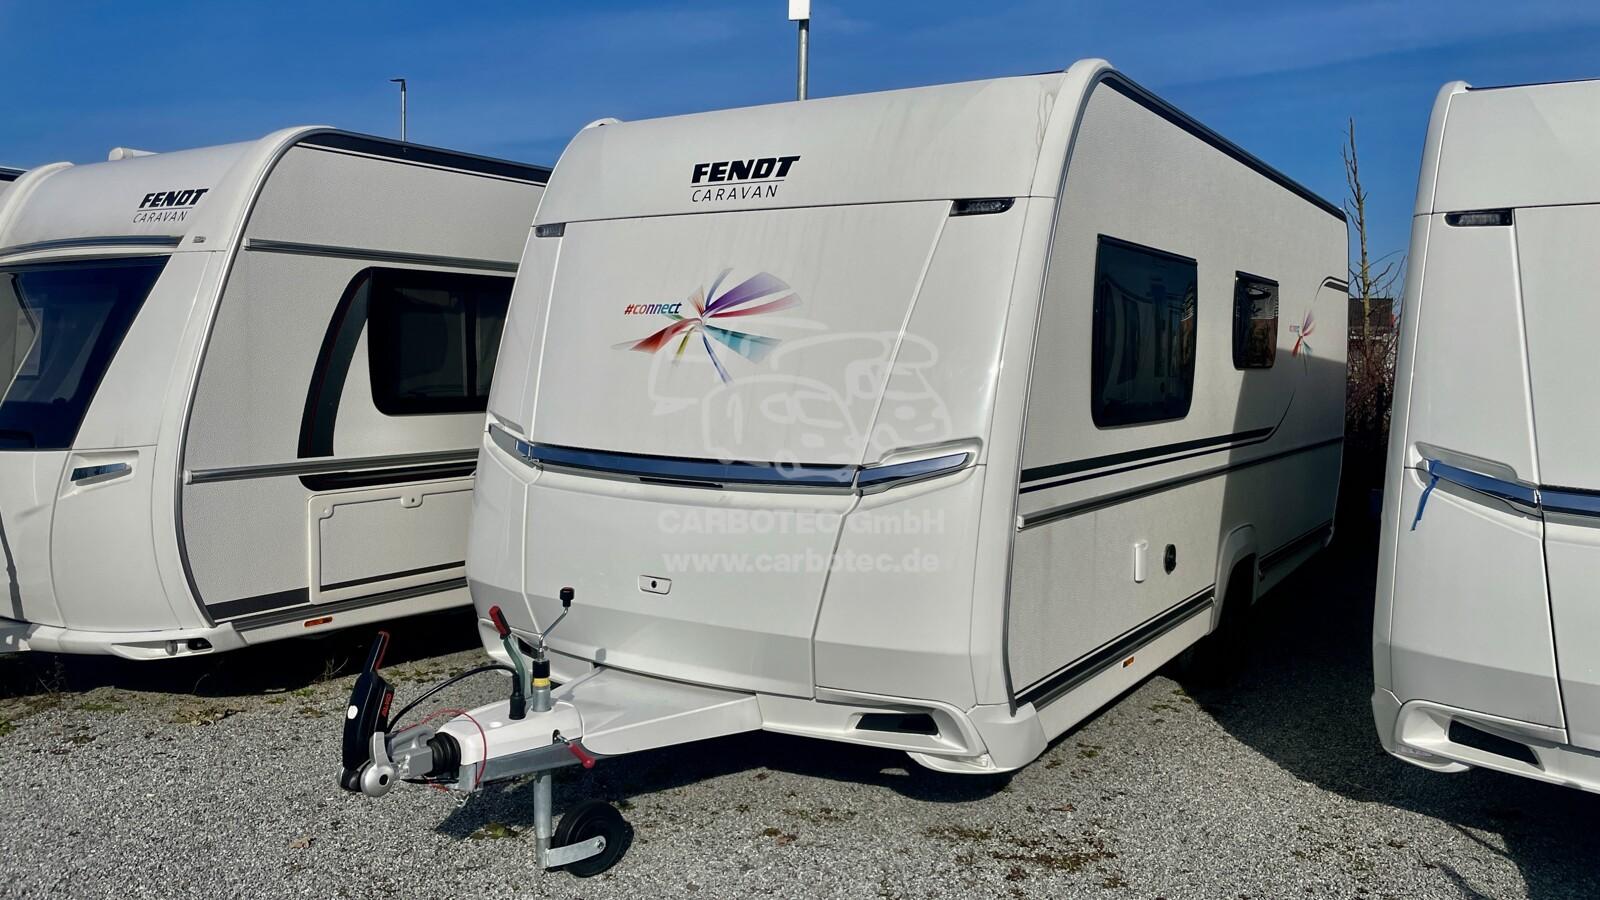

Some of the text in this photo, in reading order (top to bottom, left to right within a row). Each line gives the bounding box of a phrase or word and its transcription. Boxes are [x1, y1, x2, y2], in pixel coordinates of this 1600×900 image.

[692, 156, 800, 183] FENDT
[139, 188, 209, 209] FENDT
[692, 185, 778, 202] CARAVAN
[133, 211, 188, 224] CARAVAN
[624, 302, 682, 315] #connect
